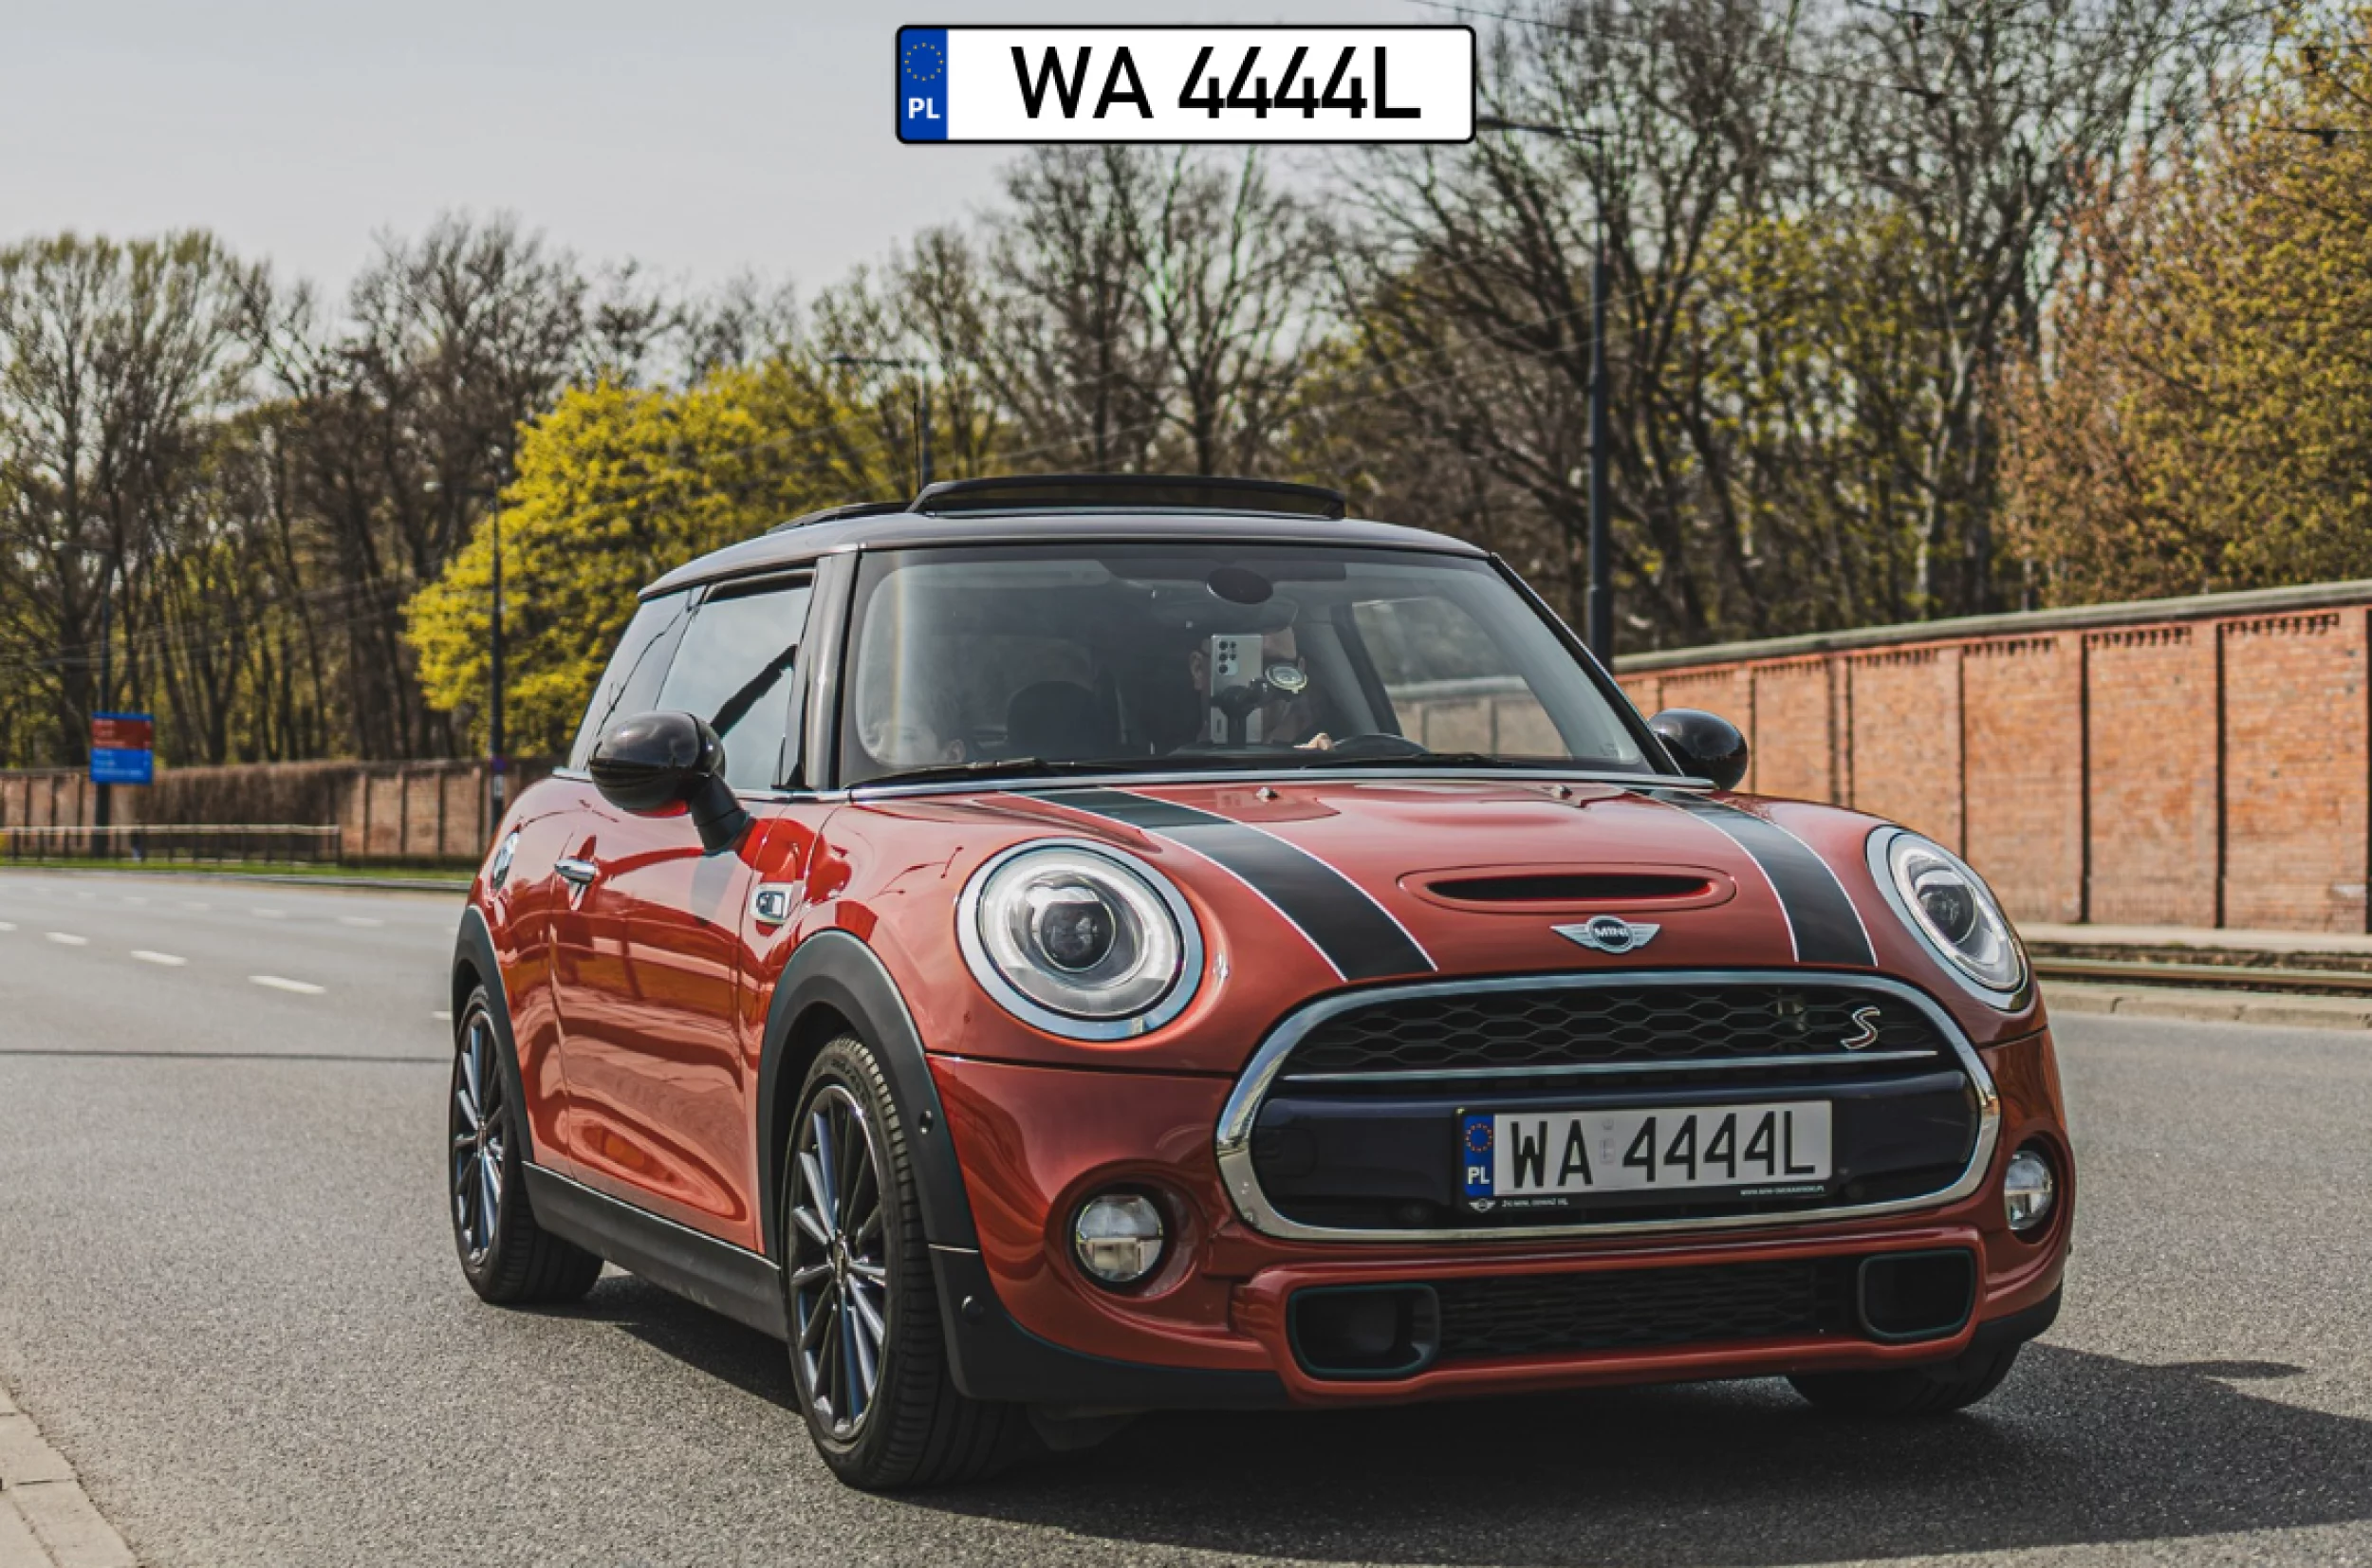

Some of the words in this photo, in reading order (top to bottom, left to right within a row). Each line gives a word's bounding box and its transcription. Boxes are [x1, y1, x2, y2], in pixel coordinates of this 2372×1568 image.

[1840, 1005, 1881, 1049] S
[1510, 1119, 1593, 1188] WA
[1622, 1110, 1816, 1183] 4444L
[1468, 1166, 1491, 1185] PL
